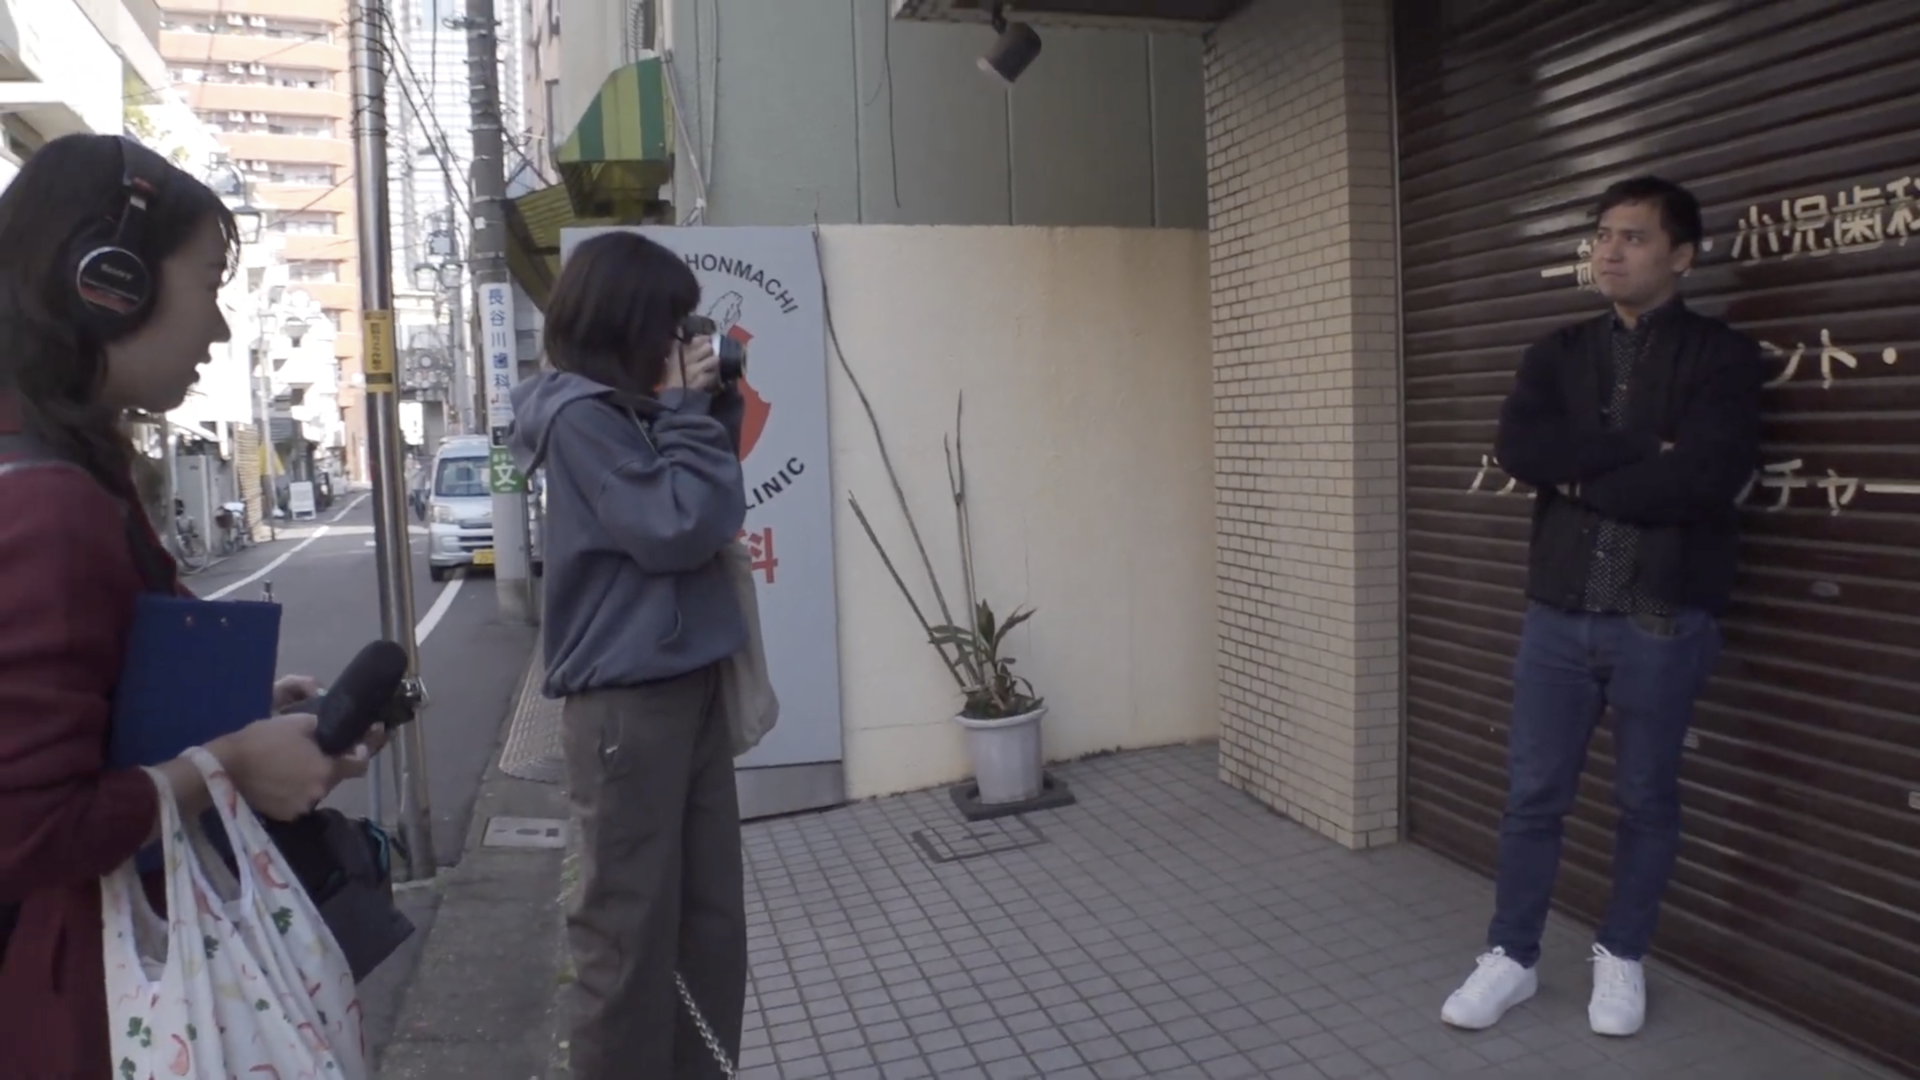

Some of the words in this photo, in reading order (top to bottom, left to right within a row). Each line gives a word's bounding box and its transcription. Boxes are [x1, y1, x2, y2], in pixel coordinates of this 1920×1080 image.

[684, 253, 799, 314] HONMACHI
[489, 287, 510, 389] 長谷川歯科
